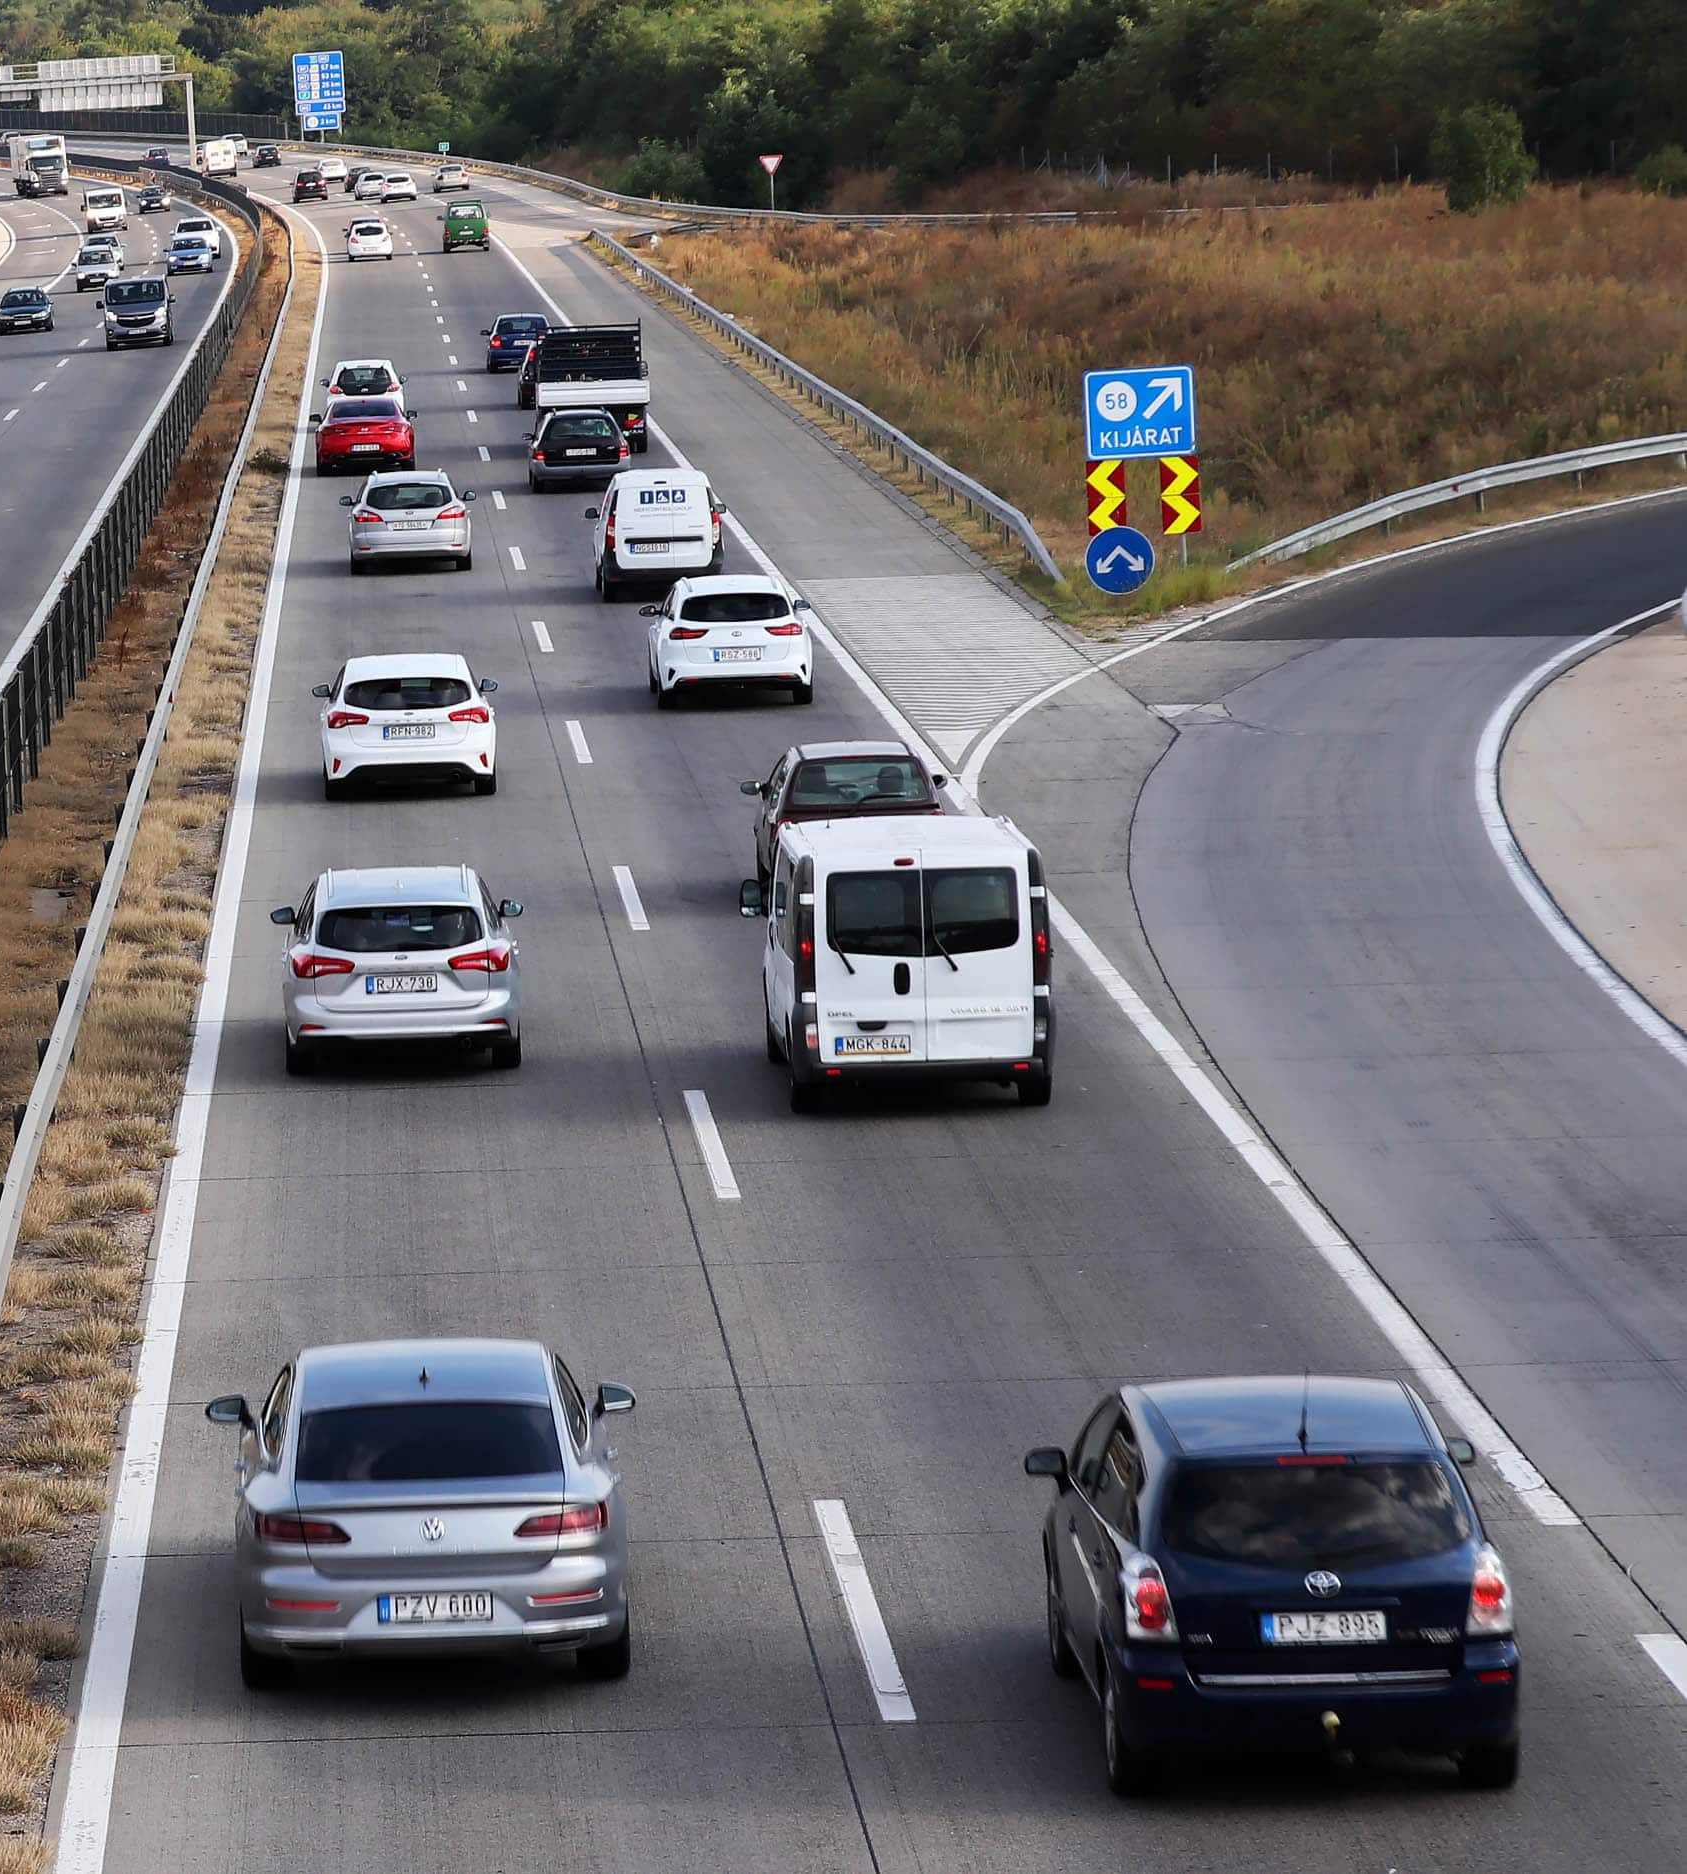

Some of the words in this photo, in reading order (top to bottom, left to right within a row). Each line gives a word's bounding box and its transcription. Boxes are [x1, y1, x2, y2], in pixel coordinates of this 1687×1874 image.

[1105, 392, 1128, 410] 58
[1100, 425, 1182, 449] KIJÁRAT
[391, 726, 432, 737] RFN-982
[376, 976, 434, 991] RJX-738
[845, 1037, 907, 1051] MGK-844
